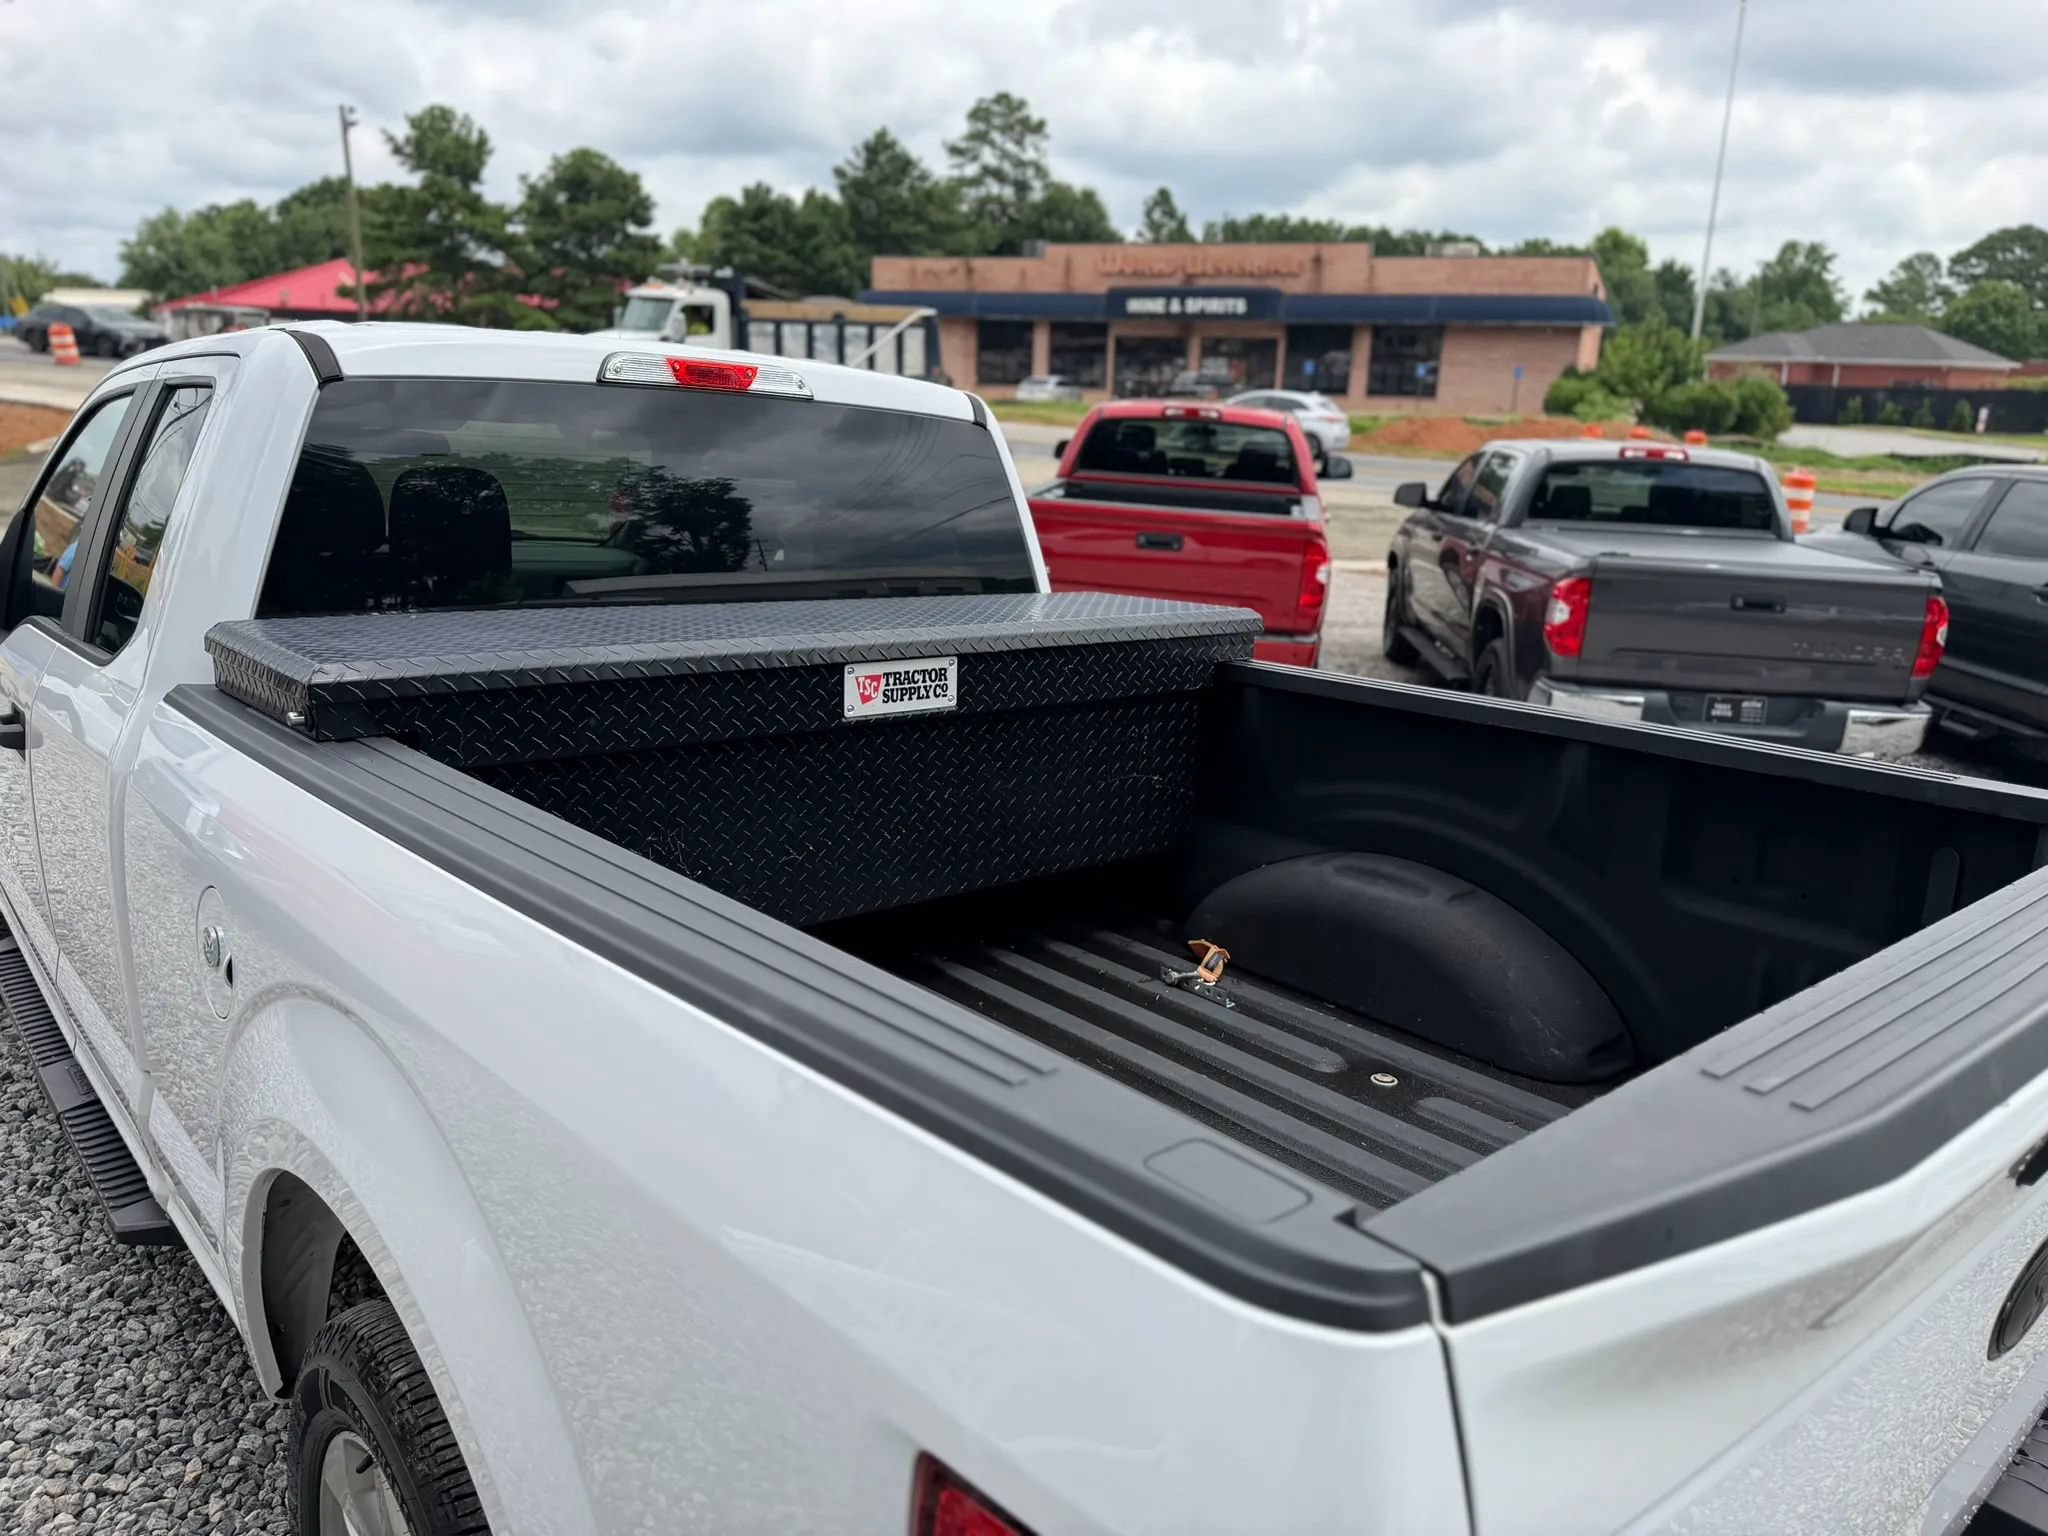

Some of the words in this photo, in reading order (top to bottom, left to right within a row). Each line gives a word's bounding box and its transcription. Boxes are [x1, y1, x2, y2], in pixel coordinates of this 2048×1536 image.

[1126, 296, 1167, 315] WINE
[1169, 297, 1182, 315] &
[1184, 296, 1248, 316] SPIRITS
[858, 676, 878, 698] TSC
[883, 668, 948, 687] TRACTOR
[882, 685, 932, 704] SUPPLY
